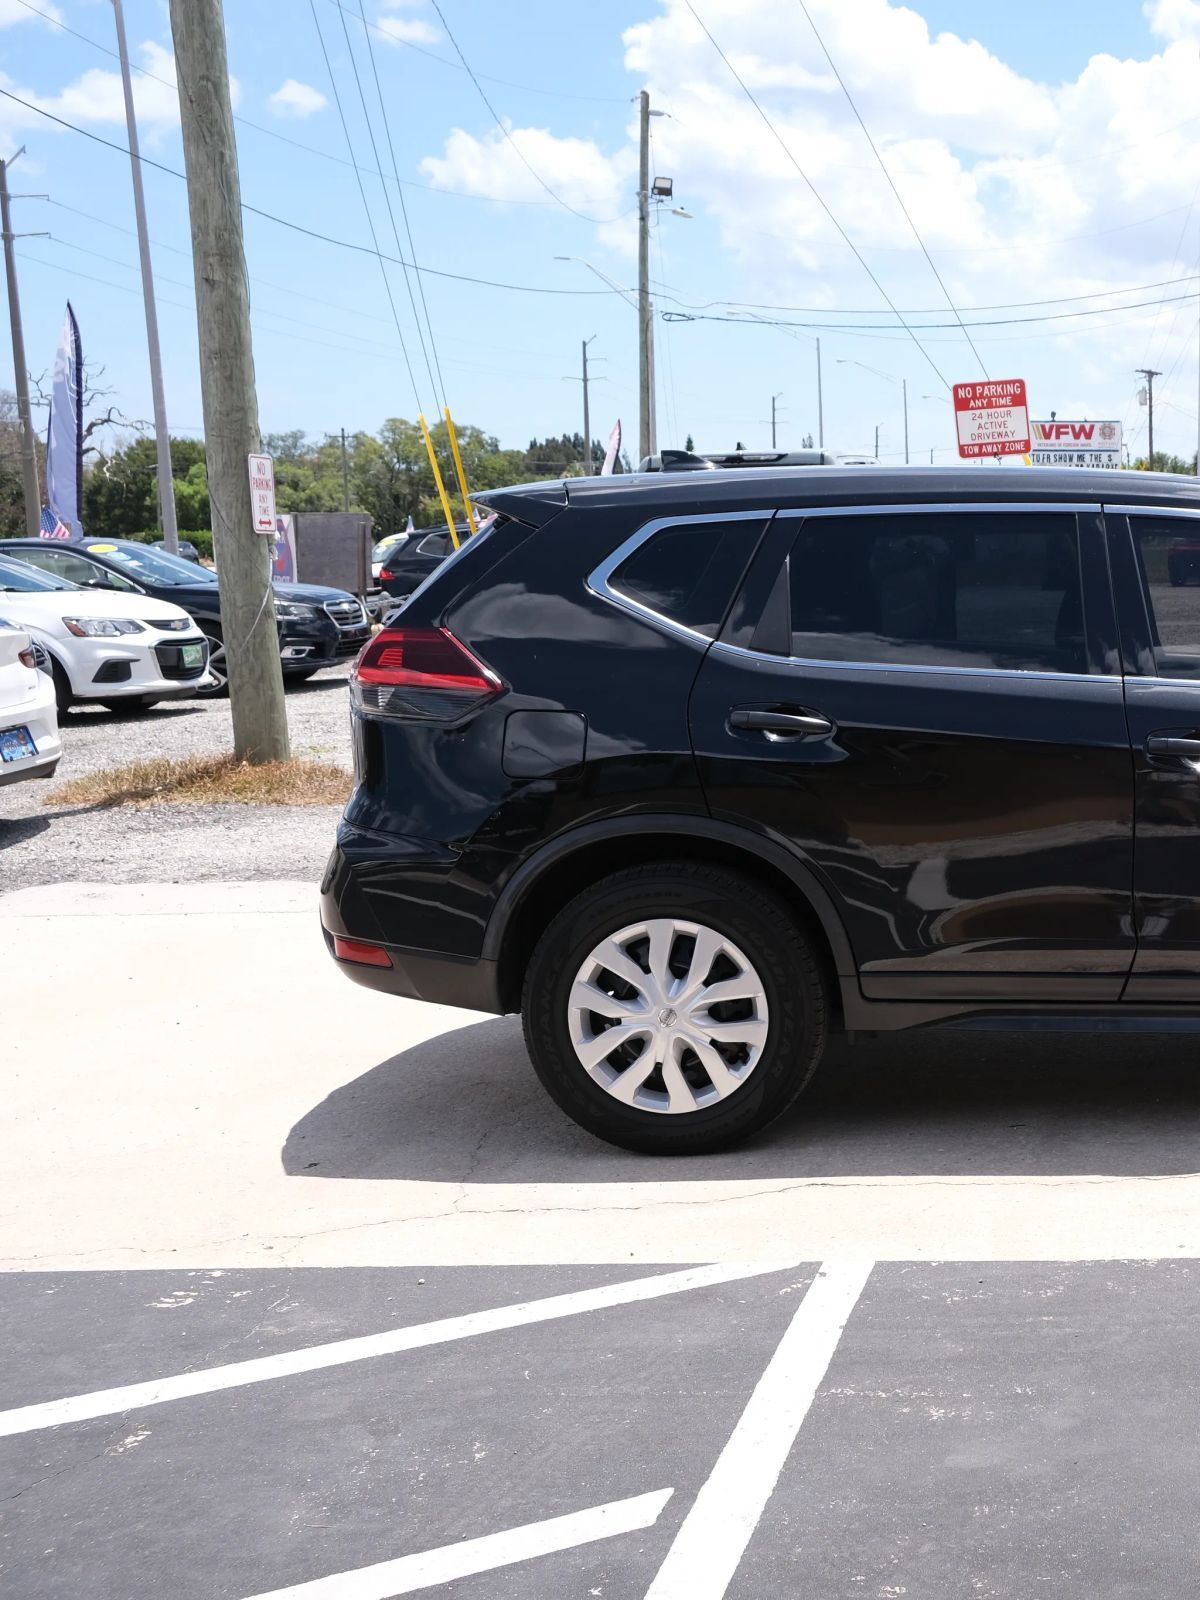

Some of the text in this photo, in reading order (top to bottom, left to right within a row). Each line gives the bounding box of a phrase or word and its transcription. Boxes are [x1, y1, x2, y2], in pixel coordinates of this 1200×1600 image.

[958, 383, 1021, 398] NO PARKING
[969, 396, 1012, 409] ANY TIME
[971, 410, 1012, 421] 24 HOUR
[977, 420, 1008, 430] ACTIVE
[970, 430, 1015, 441] DRIVEWAY
[1040, 424, 1095, 440] VFW
[963, 441, 1025, 455] TOW AWAY ZONE
[1053, 453, 1074, 463] SHOW
[1077, 453, 1085, 463] ME
[1090, 453, 1102, 463] THE
[257, 461, 265, 476] NO
[253, 477, 271, 491] PARKING
[258, 494, 268, 504] ANY
[259, 505, 270, 516] TIME
